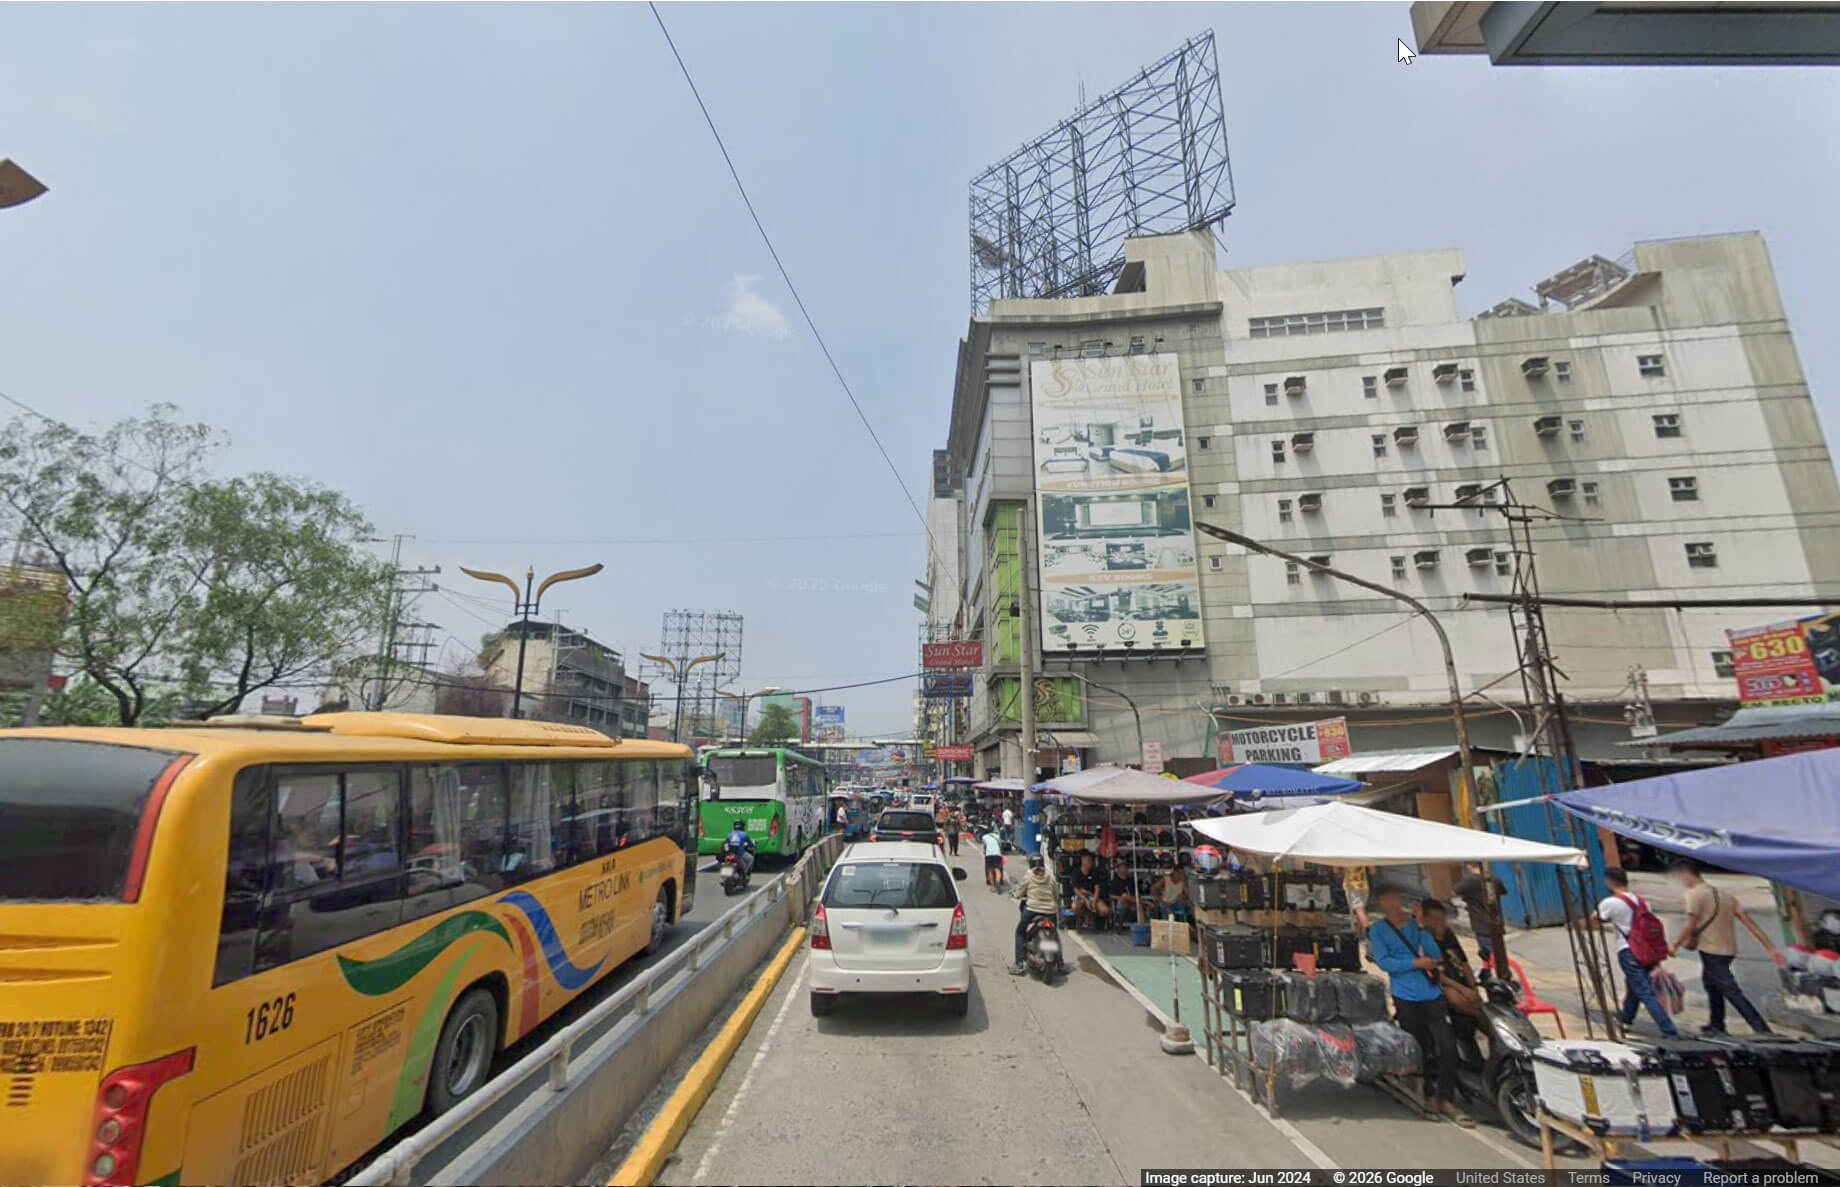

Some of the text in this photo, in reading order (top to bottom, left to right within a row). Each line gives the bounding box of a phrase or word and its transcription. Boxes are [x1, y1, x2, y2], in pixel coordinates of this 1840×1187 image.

[1130, 361, 1173, 377] Star
[926, 642, 980, 658] Sun Star
[1231, 725, 1316, 745] MOTORCYCLE
[1245, 747, 1302, 762] PARKING
[245, 992, 296, 1045] 1626
